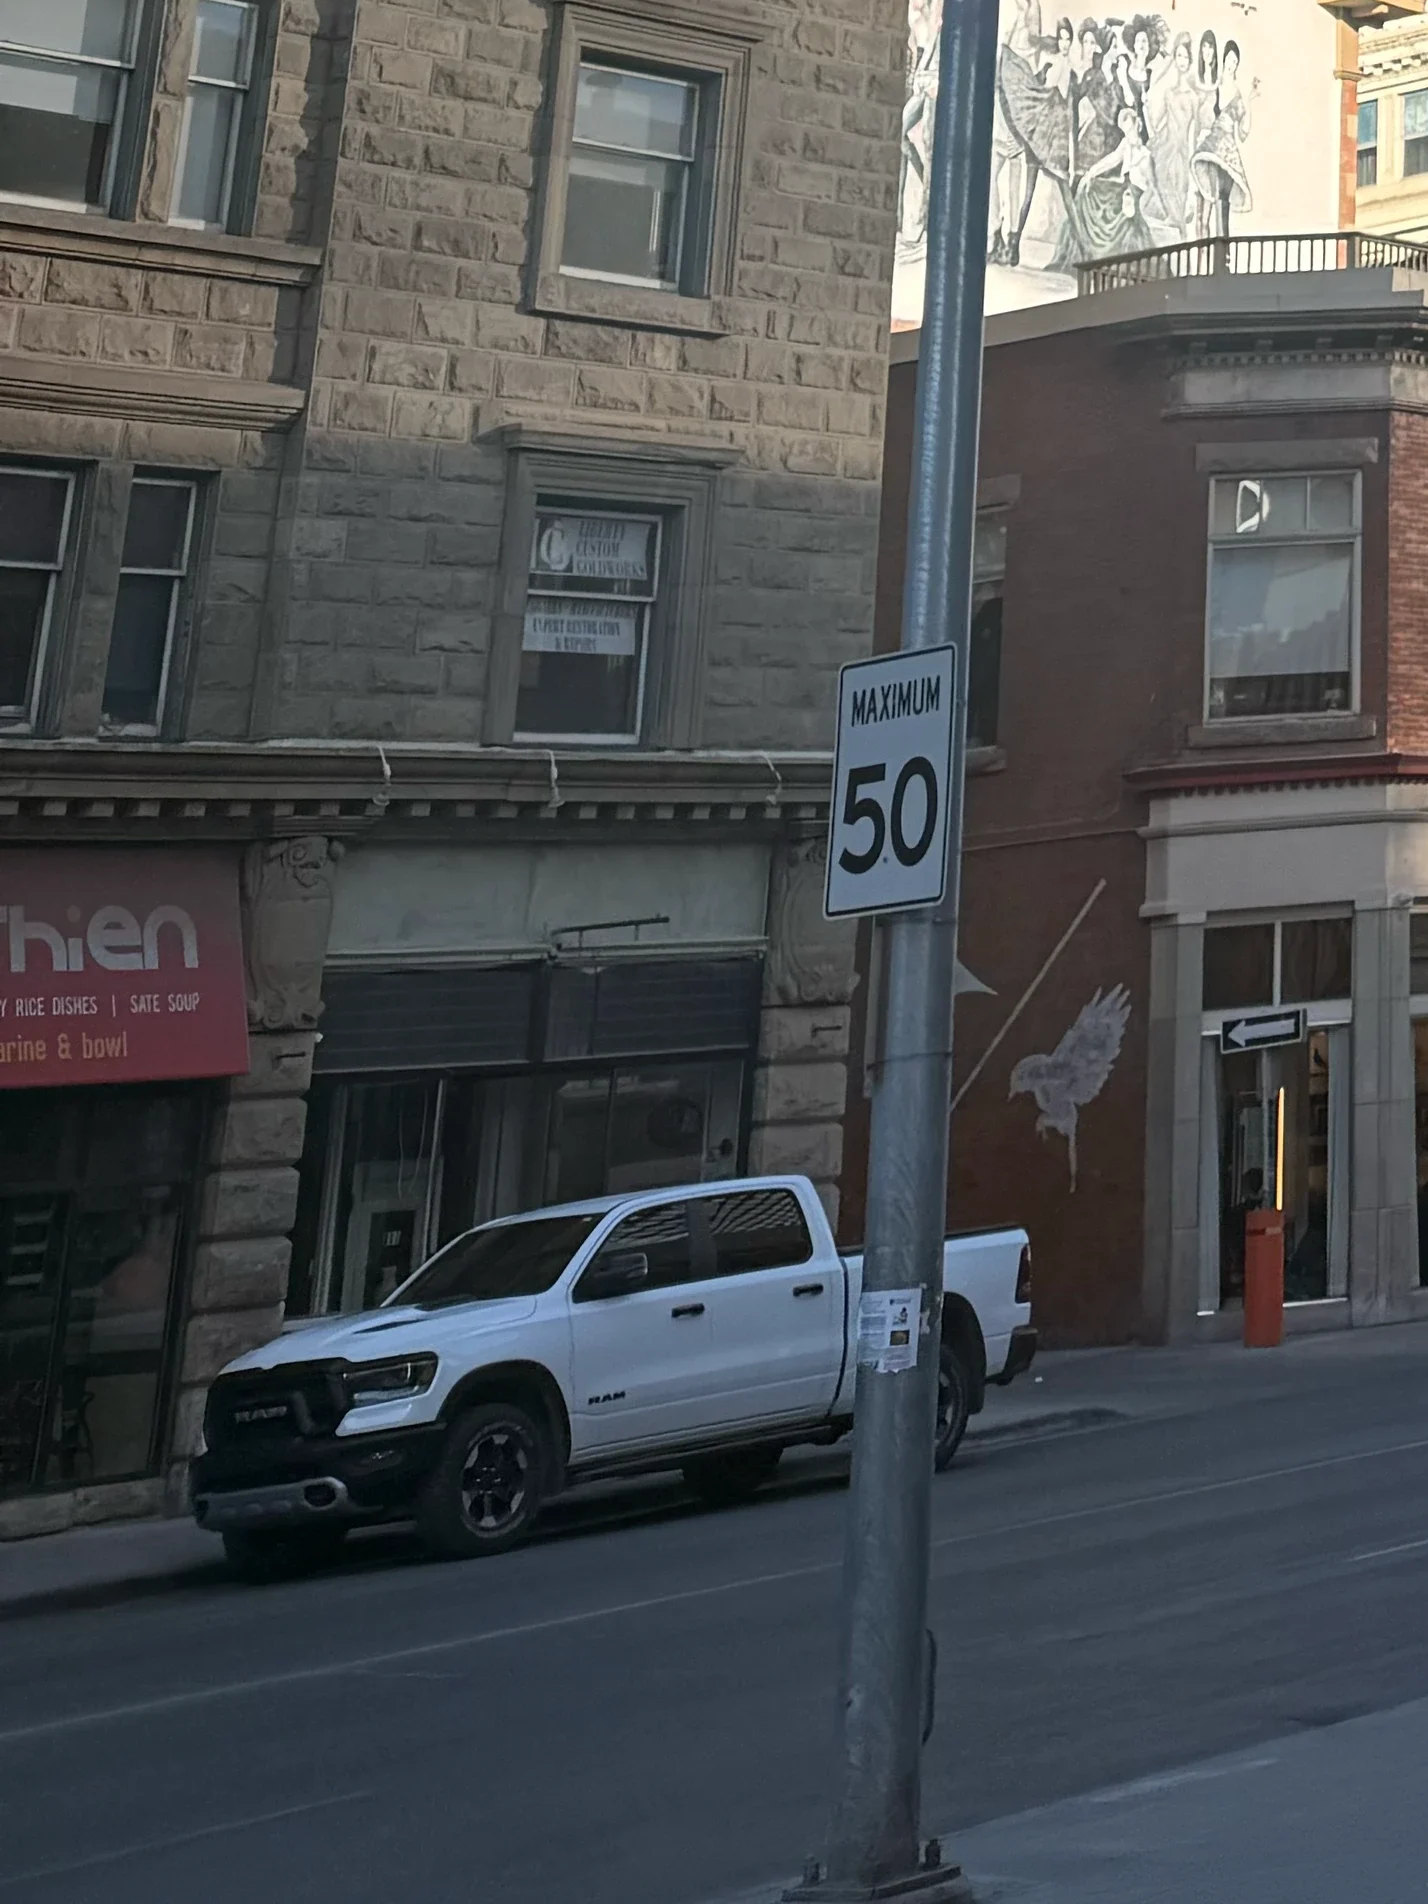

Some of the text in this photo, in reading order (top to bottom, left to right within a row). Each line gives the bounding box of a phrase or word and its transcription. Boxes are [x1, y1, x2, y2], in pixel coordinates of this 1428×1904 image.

[851, 675, 941, 727] MAXIMUM
[838, 755, 938, 875] 50
[15, 996, 46, 1017] RICE
[52, 995, 98, 1016] DISHES
[130, 994, 161, 1014] SATE
[168, 992, 201, 1013] SOUP
[57, 1032, 72, 1060] &
[82, 1030, 128, 1060] bowl
[588, 1390, 626, 1406] RAM
